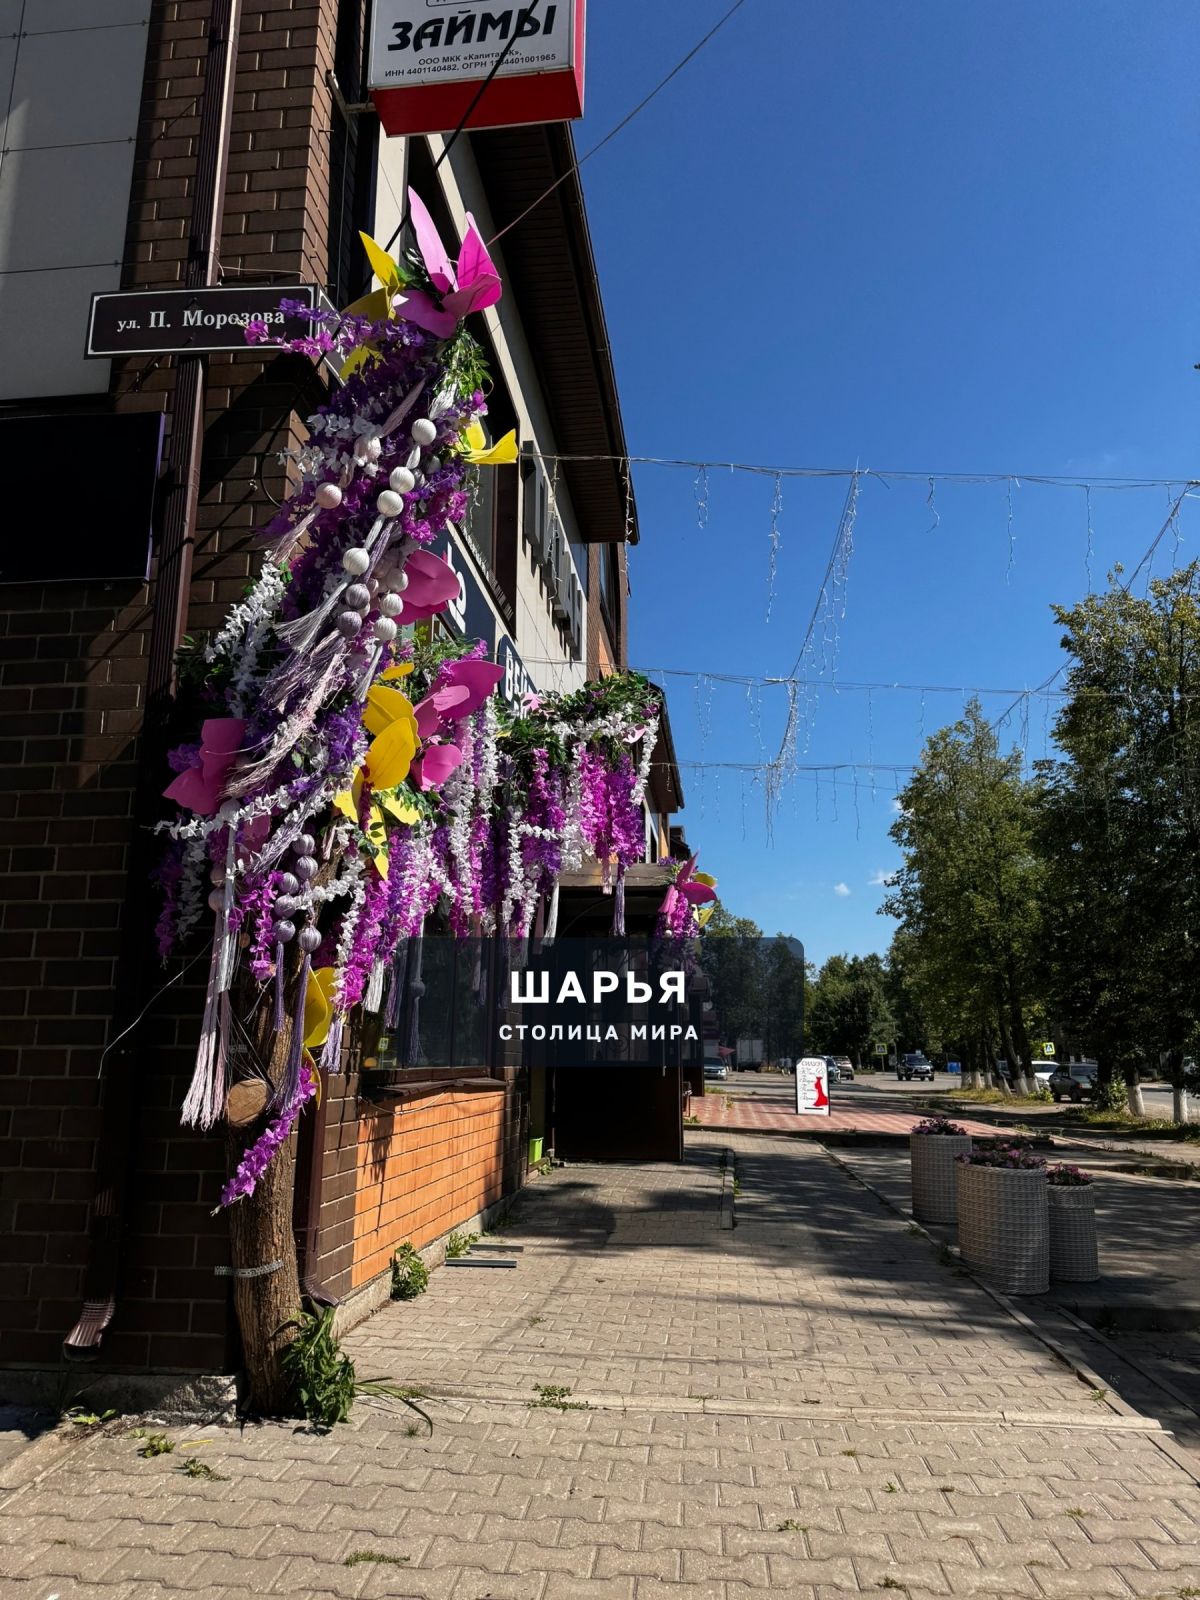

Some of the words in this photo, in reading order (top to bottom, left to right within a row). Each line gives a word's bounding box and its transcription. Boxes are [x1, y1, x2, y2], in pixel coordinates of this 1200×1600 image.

[387, 5, 557, 52] ЗАЙМЫ
[384, 69, 405, 77] ИНН
[406, 64, 460, 75] 4401140482,
[461, 61, 487, 70] ОГРН
[489, 53, 556, 67] 14401001965
[418, 57, 440, 66] ООО
[442, 54, 461, 63] МКК
[463, 49, 522, 61] «КапитаК»,
[117, 317, 141, 332] ул.
[149, 310, 171, 328] П.
[182, 309, 285, 330] Морозова
